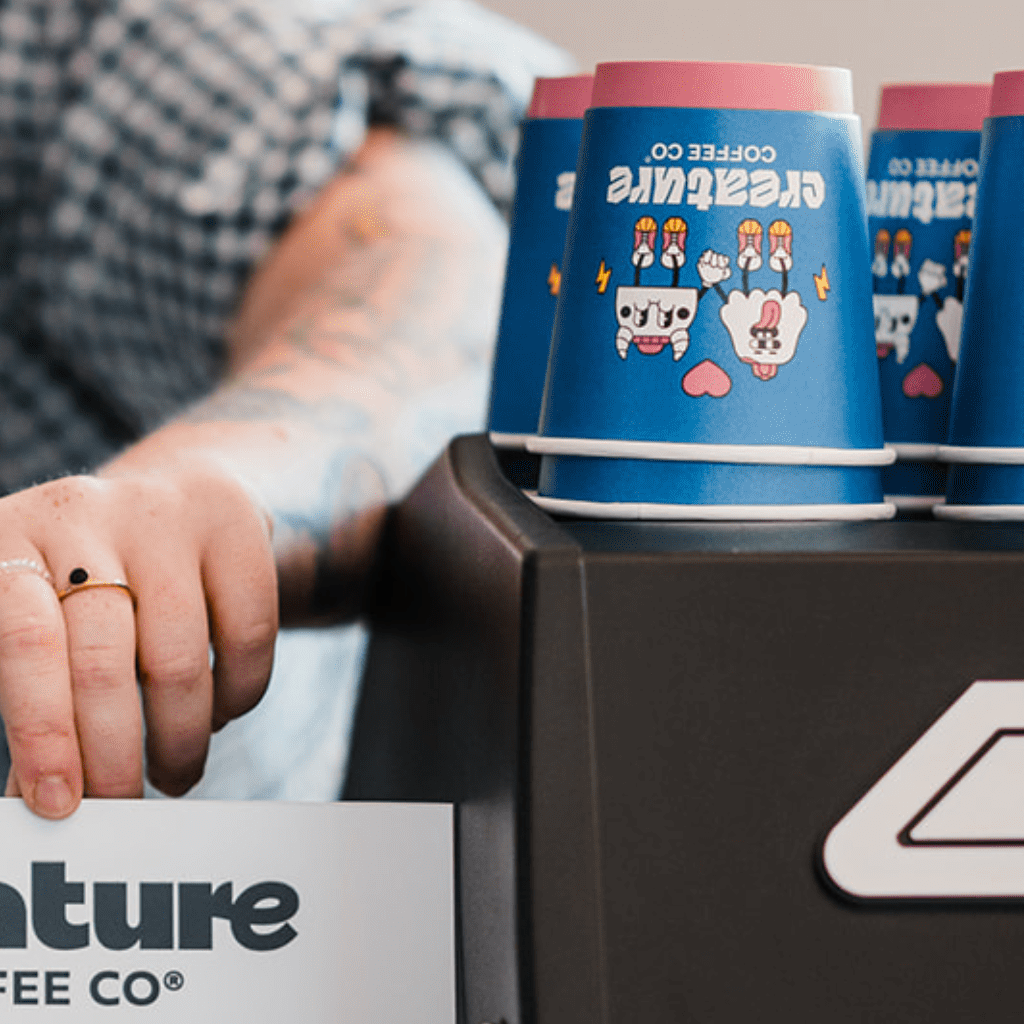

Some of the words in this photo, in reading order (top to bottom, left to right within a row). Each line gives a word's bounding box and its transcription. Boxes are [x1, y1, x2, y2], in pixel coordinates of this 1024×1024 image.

[687, 143, 777, 163] COFFEE
[914, 157, 979, 178] OFFEE
[605, 164, 826, 211] creature
[89, 970, 185, 1007] CO®
